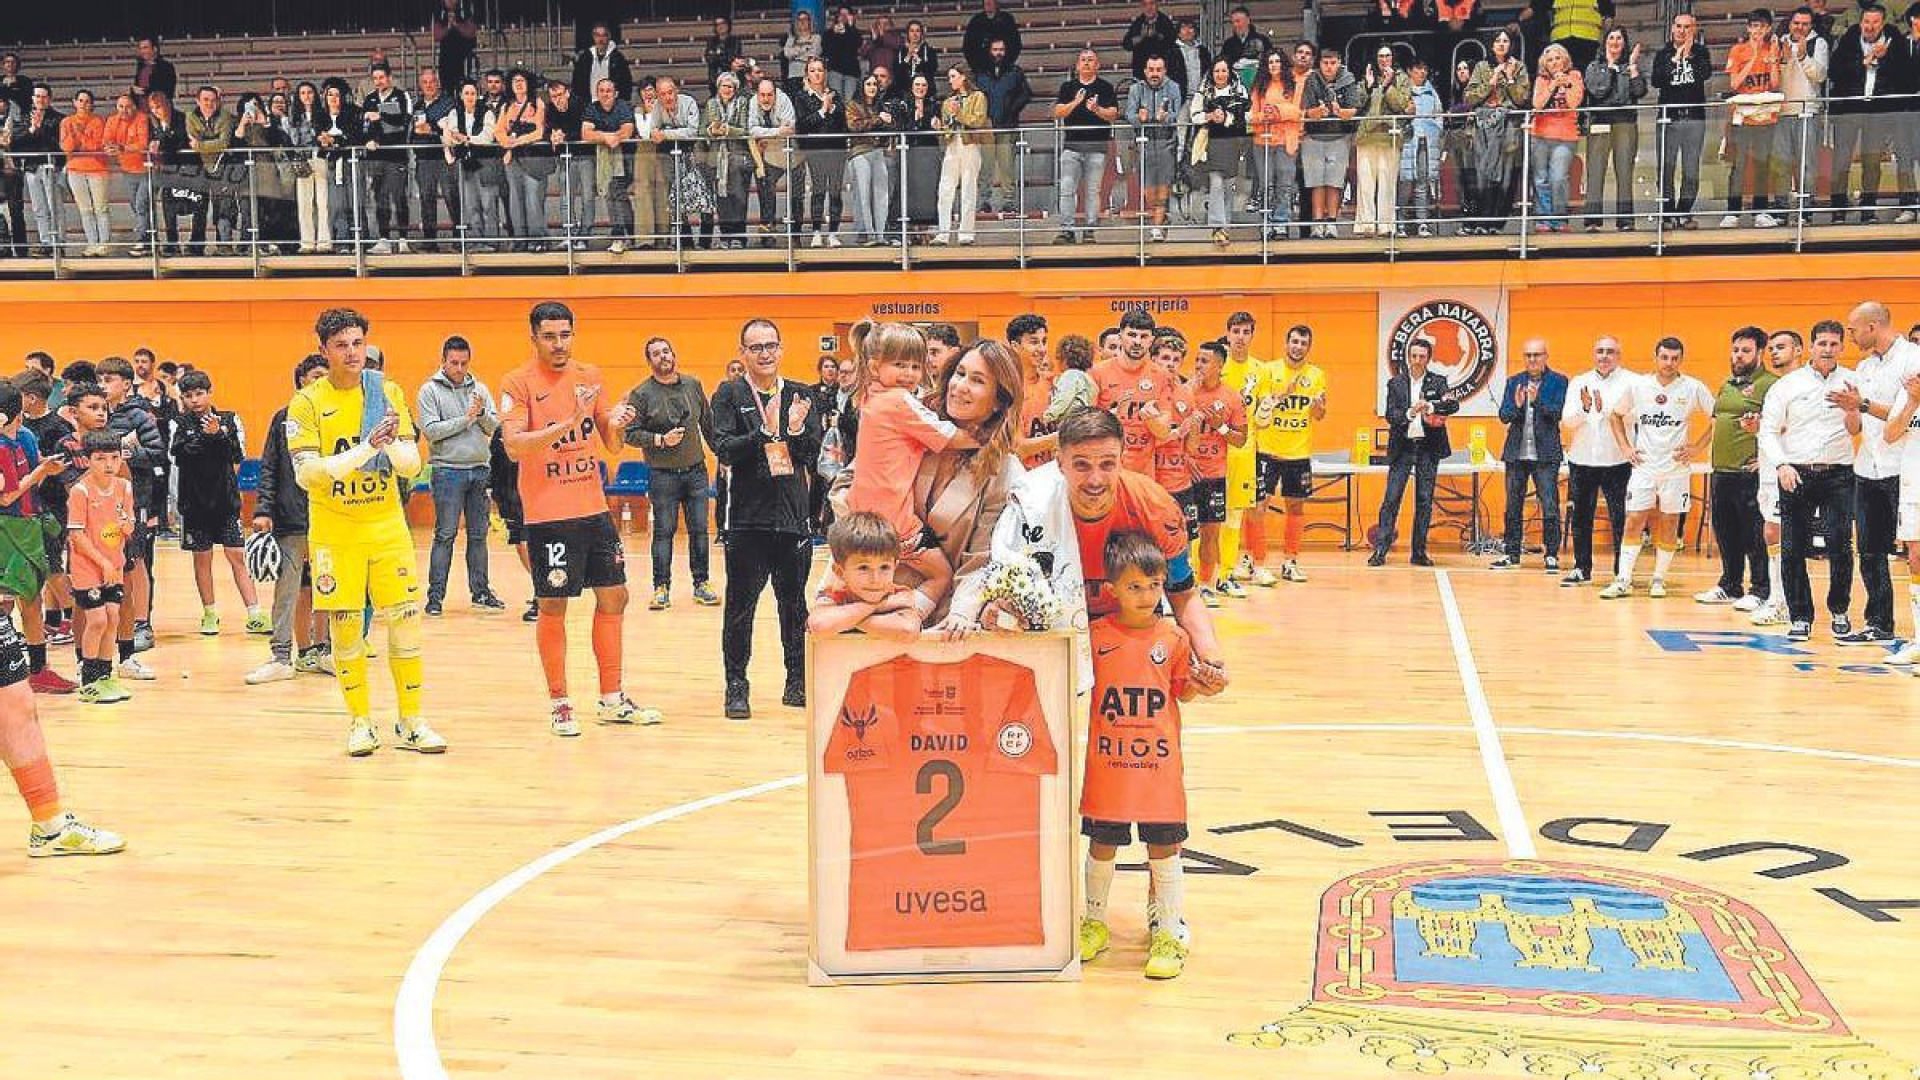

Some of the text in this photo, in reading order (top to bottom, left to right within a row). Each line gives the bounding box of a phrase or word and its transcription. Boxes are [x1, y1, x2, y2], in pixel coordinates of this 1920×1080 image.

[872, 301, 940, 315] vestuarios
[1438, 303, 1494, 361] NAVARRA
[1275, 395, 1311, 411] ATP
[1273, 417, 1308, 428] RIOS
[546, 456, 596, 478] RIOS
[332, 472, 388, 498] RIOS
[545, 541, 568, 567] 12
[1100, 686, 1166, 721] ATP
[911, 735, 968, 752] DAVID
[1098, 735, 1169, 758] RIOS
[1108, 760, 1159, 771] renovables
[916, 759, 966, 855] 2
[895, 889, 987, 914] uvesa
